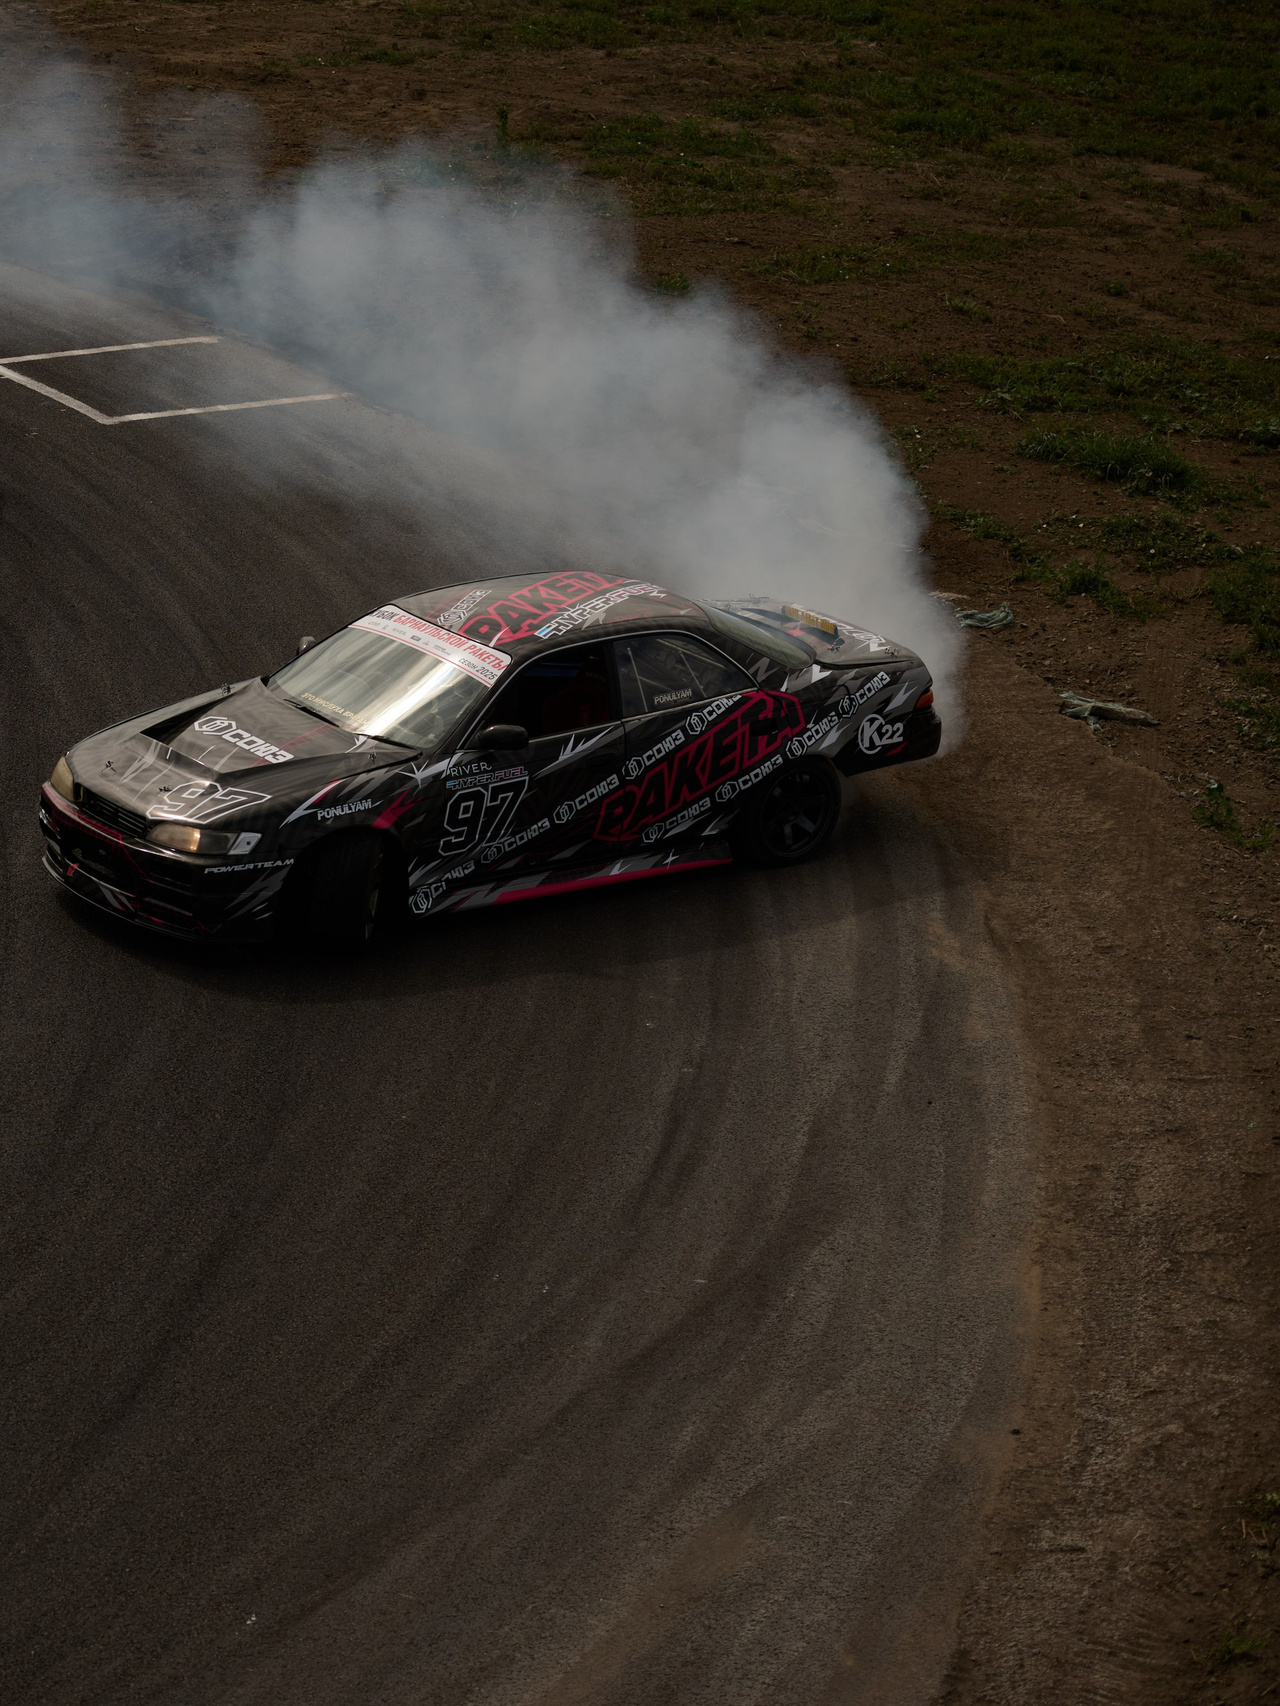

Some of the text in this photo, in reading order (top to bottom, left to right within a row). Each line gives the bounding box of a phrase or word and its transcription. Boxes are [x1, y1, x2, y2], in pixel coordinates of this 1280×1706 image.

[393, 615, 467, 649] БАРНАУЛЬСКОЙ
[463, 645, 509, 671] РАКЕТЫ
[458, 658, 498, 680] СЕЗОН 2025
[654, 689, 692, 705] PONULYAM
[221, 728, 295, 763] СОЮЗ
[666, 671, 891, 830] СОЮЗ СОЮЗ СОЮЗ СОЮЗ
[450, 761, 493, 778] RIVER
[145, 780, 273, 825] 97
[317, 798, 372, 821] PONULYAM
[504, 818, 551, 852] СОЮЗ
[575, 774, 620, 811] СОЮЗ
[644, 731, 686, 767] СОЮЗ
[438, 776, 529, 857] 97
